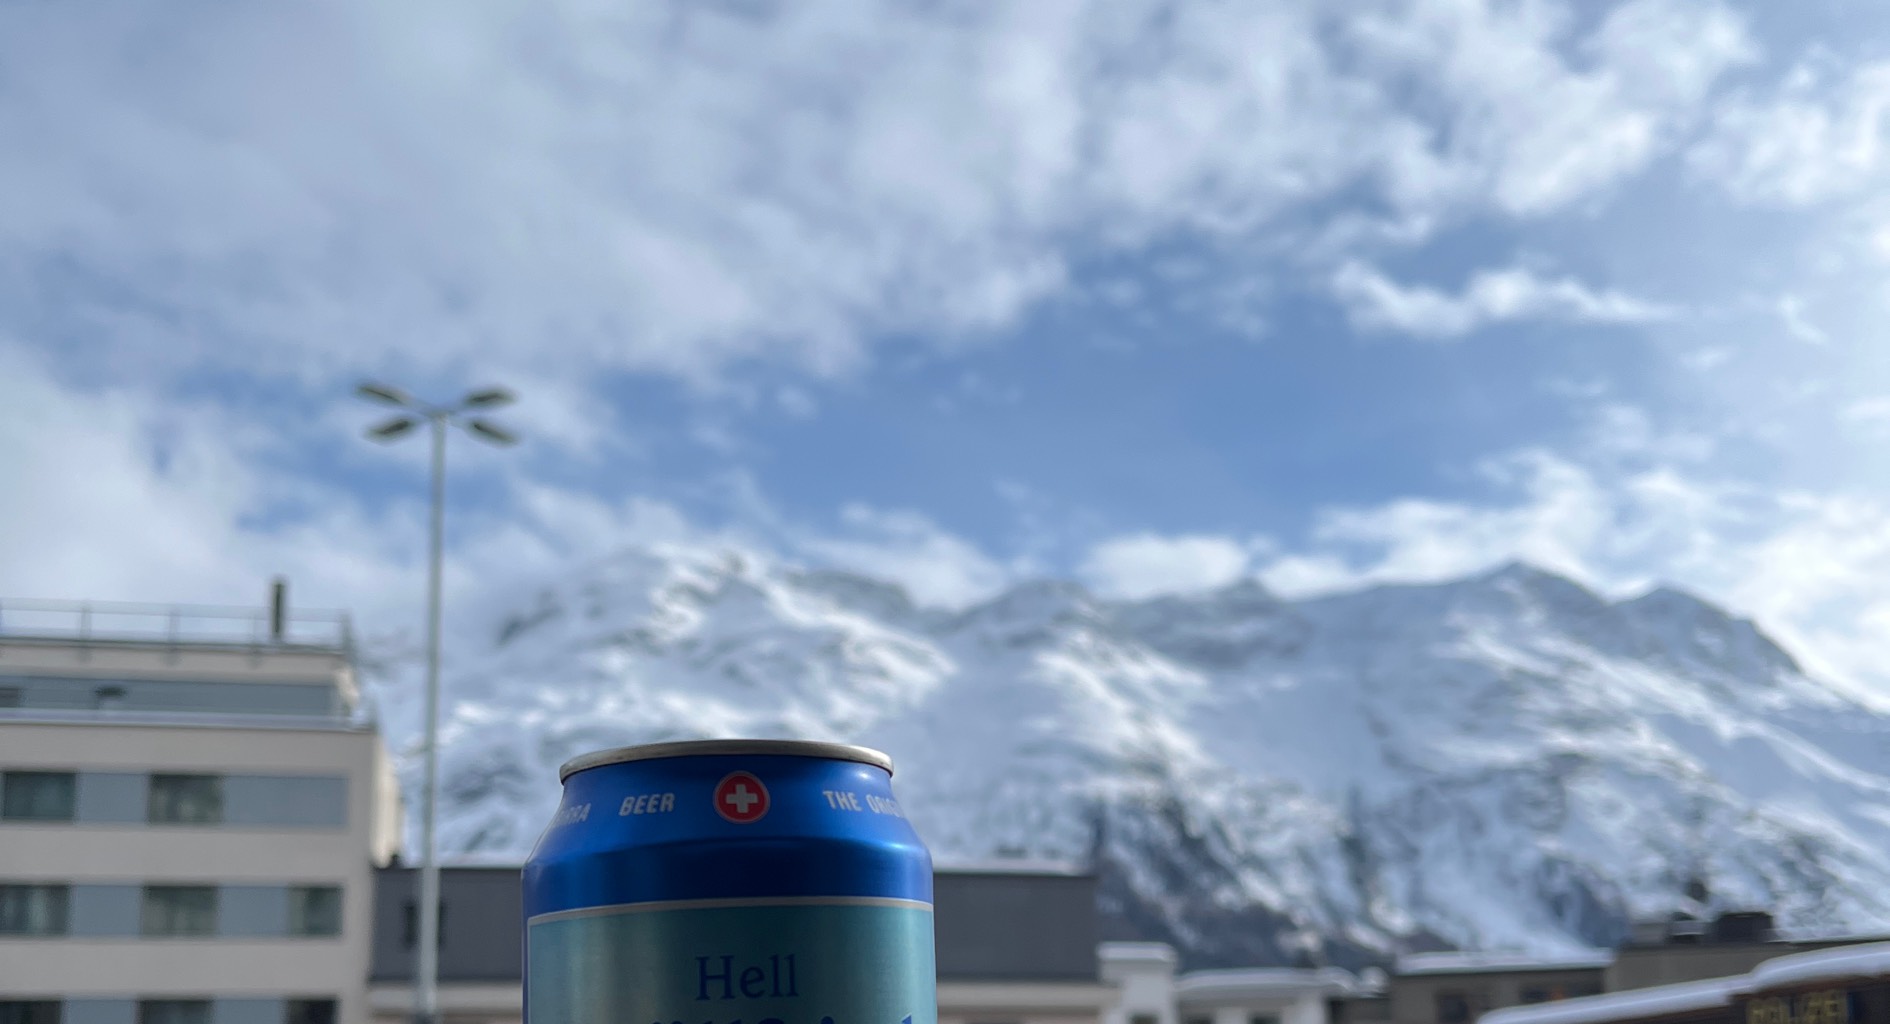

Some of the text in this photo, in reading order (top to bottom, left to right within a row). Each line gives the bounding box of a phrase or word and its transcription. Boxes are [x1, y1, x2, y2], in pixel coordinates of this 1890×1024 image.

[618, 793, 675, 817] BEER
[822, 790, 863, 812] THE
[695, 953, 799, 1001] Hell
